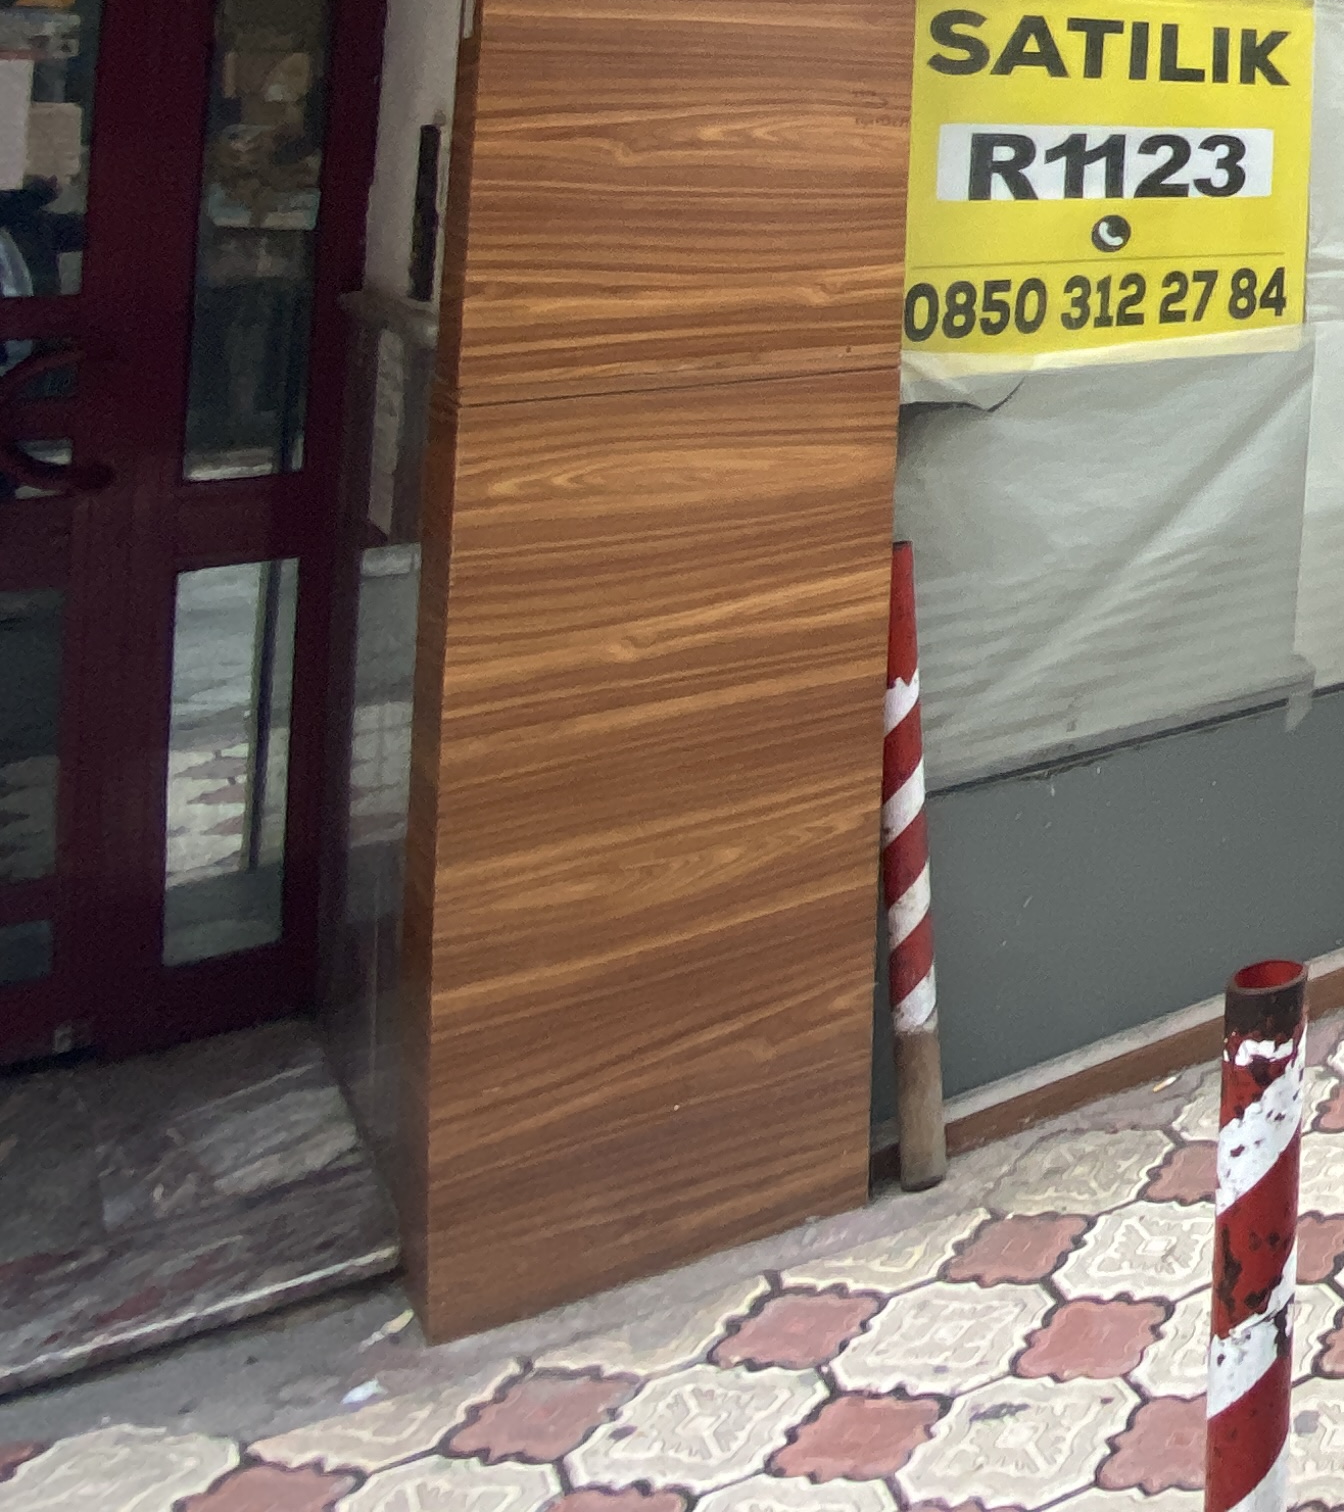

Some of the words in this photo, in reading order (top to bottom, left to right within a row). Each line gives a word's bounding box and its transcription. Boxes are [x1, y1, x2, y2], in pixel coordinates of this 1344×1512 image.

[927, 9, 1292, 86] SATILIK
[968, 133, 1247, 202] R1123
[904, 277, 1048, 342] 0850
[1060, 272, 1147, 331] 312
[1158, 270, 1219, 324] 27
[1228, 266, 1287, 320] 84
